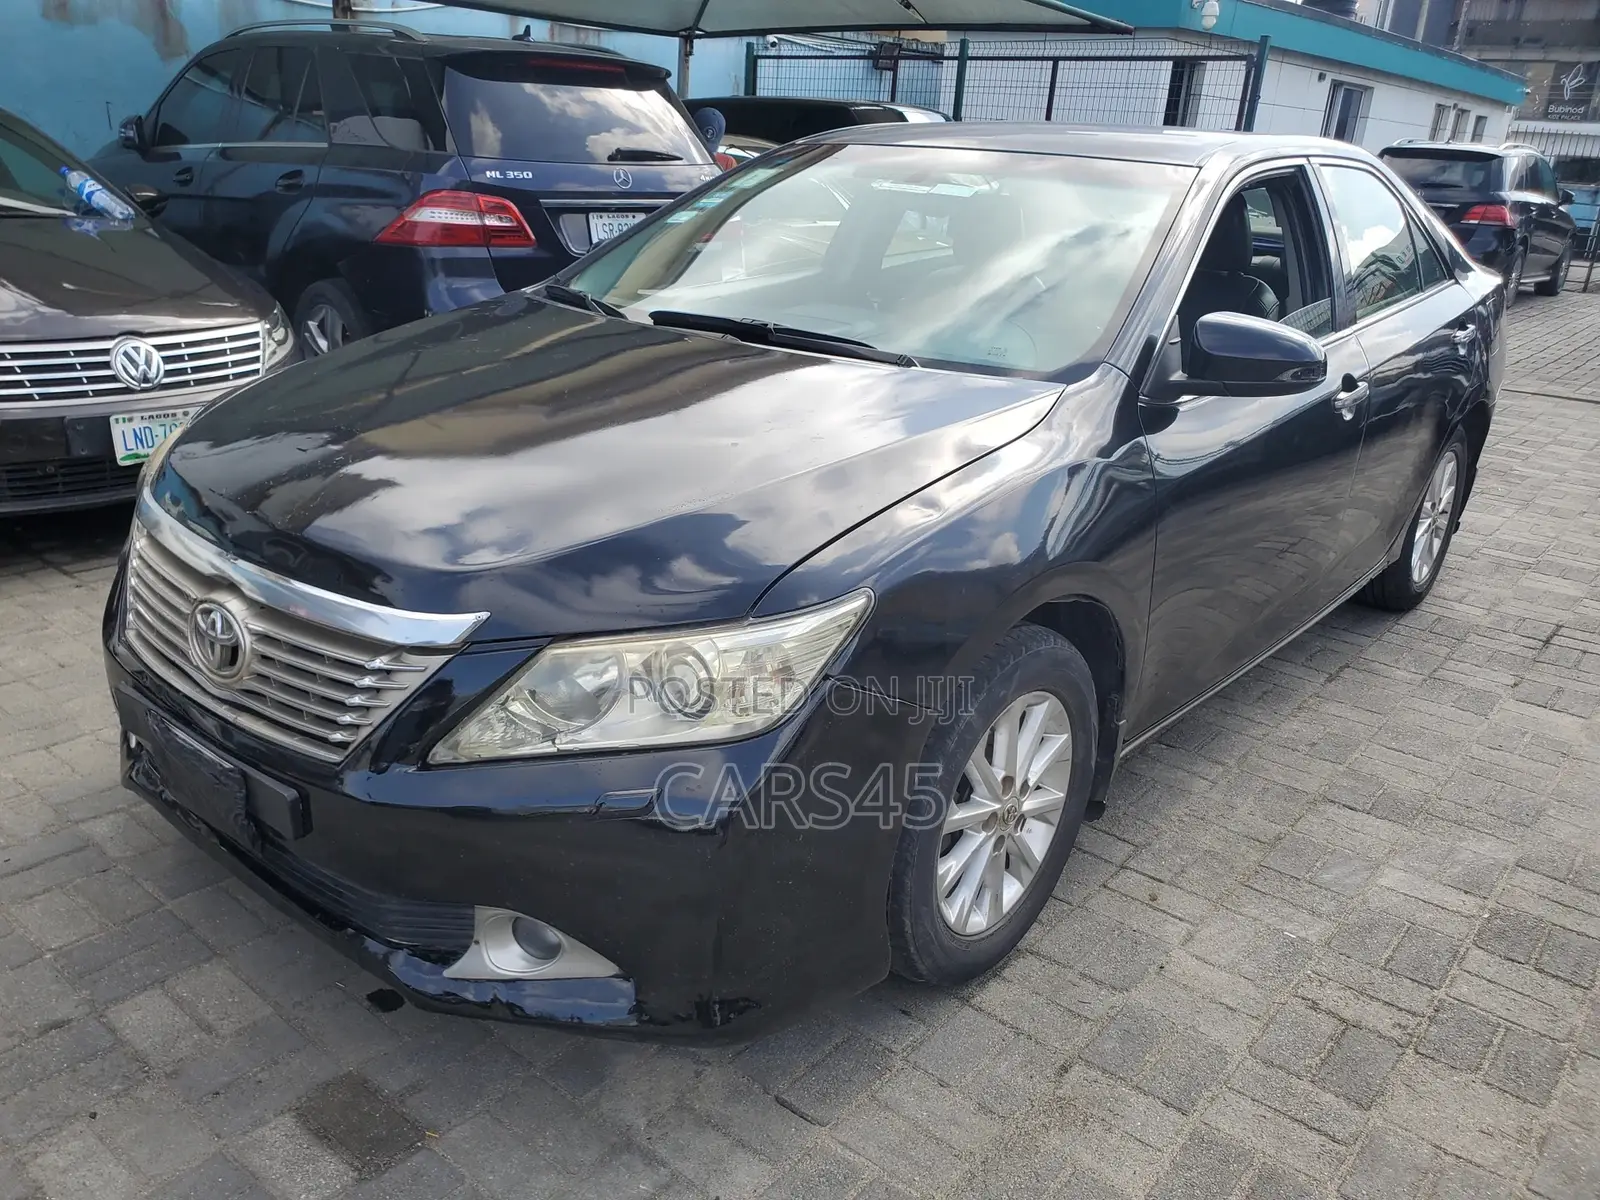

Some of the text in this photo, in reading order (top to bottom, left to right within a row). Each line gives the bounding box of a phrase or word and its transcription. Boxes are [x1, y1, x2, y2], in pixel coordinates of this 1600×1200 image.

[1548, 104, 1584, 114] Bubinod
[485, 170, 533, 179] ML 350
[140, 412, 177, 420] LAGOS
